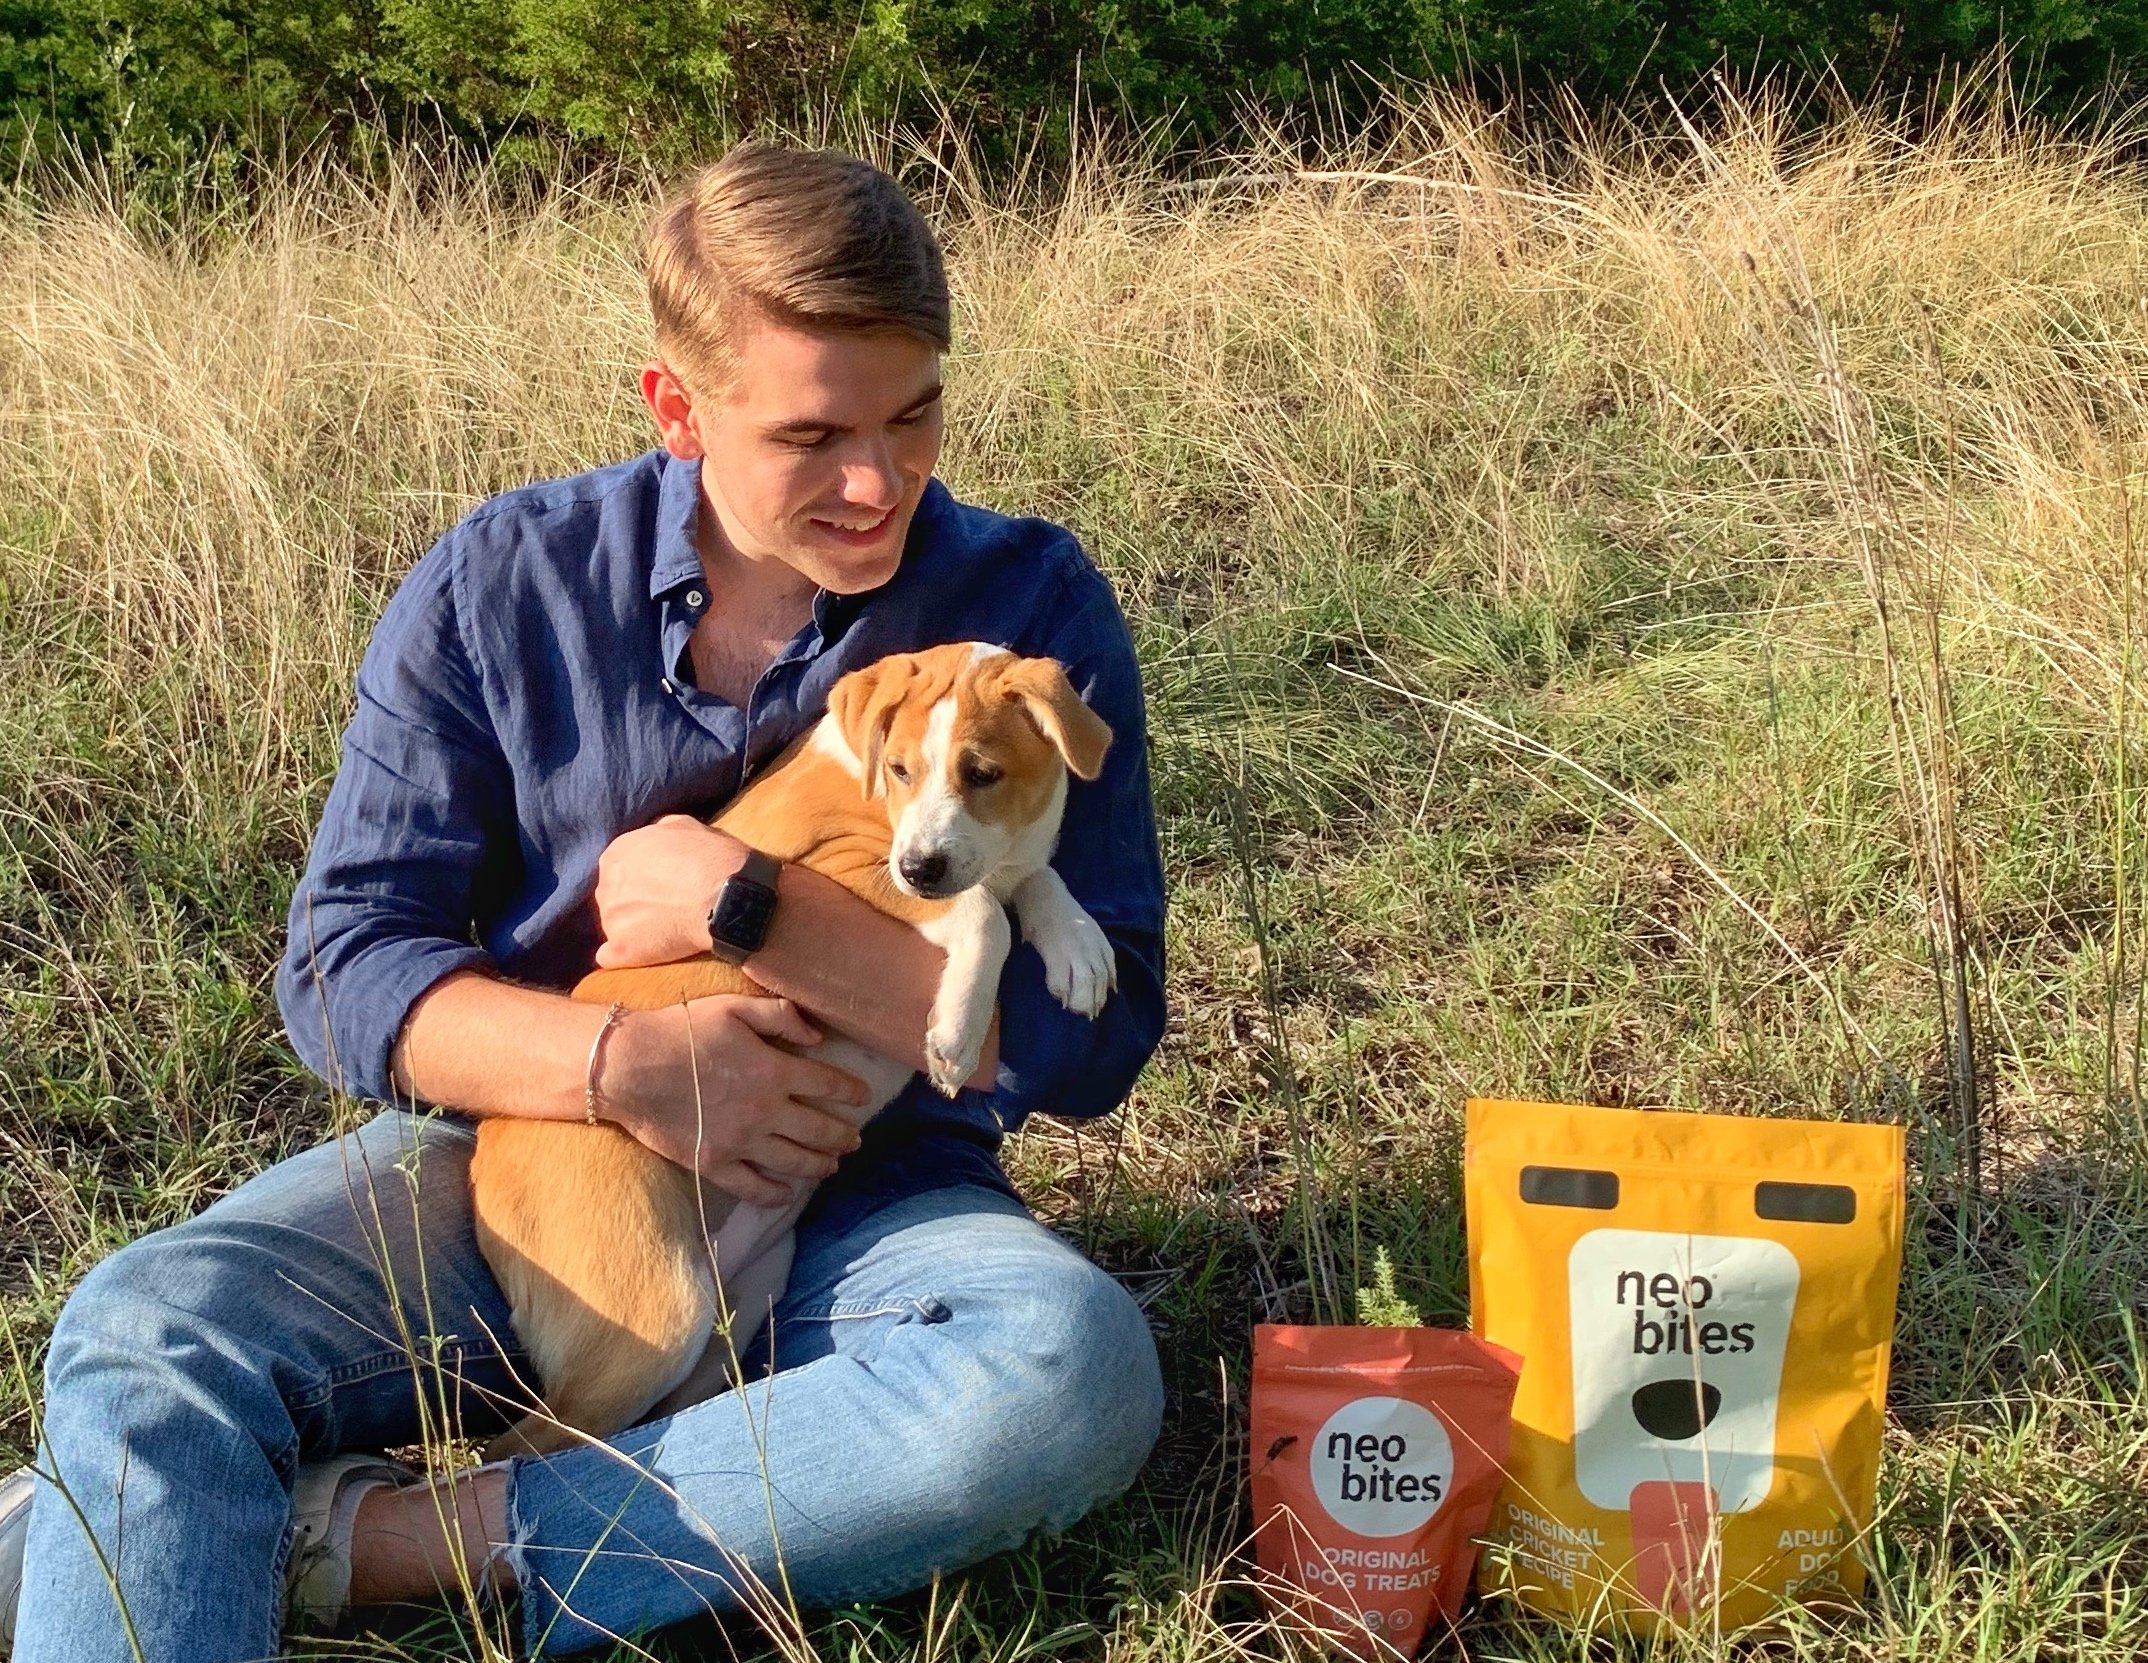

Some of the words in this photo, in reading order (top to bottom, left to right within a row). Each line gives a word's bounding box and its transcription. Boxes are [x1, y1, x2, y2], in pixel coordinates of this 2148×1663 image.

[1617, 1270, 1713, 1309] neo
[1634, 1309, 1755, 1355] bites
[1327, 1432, 1406, 1462] neo
[1341, 1463, 1441, 1502] bites
[1508, 1503, 1605, 1546] ORIGINAL
[1321, 1547, 1431, 1569] ORIGINAL
[1509, 1524, 1592, 1570] CRICKET
[1306, 1561, 1357, 1589] DOG
[1364, 1564, 1441, 1591] TREATS
[1512, 1548, 1575, 1590] ECIPE
